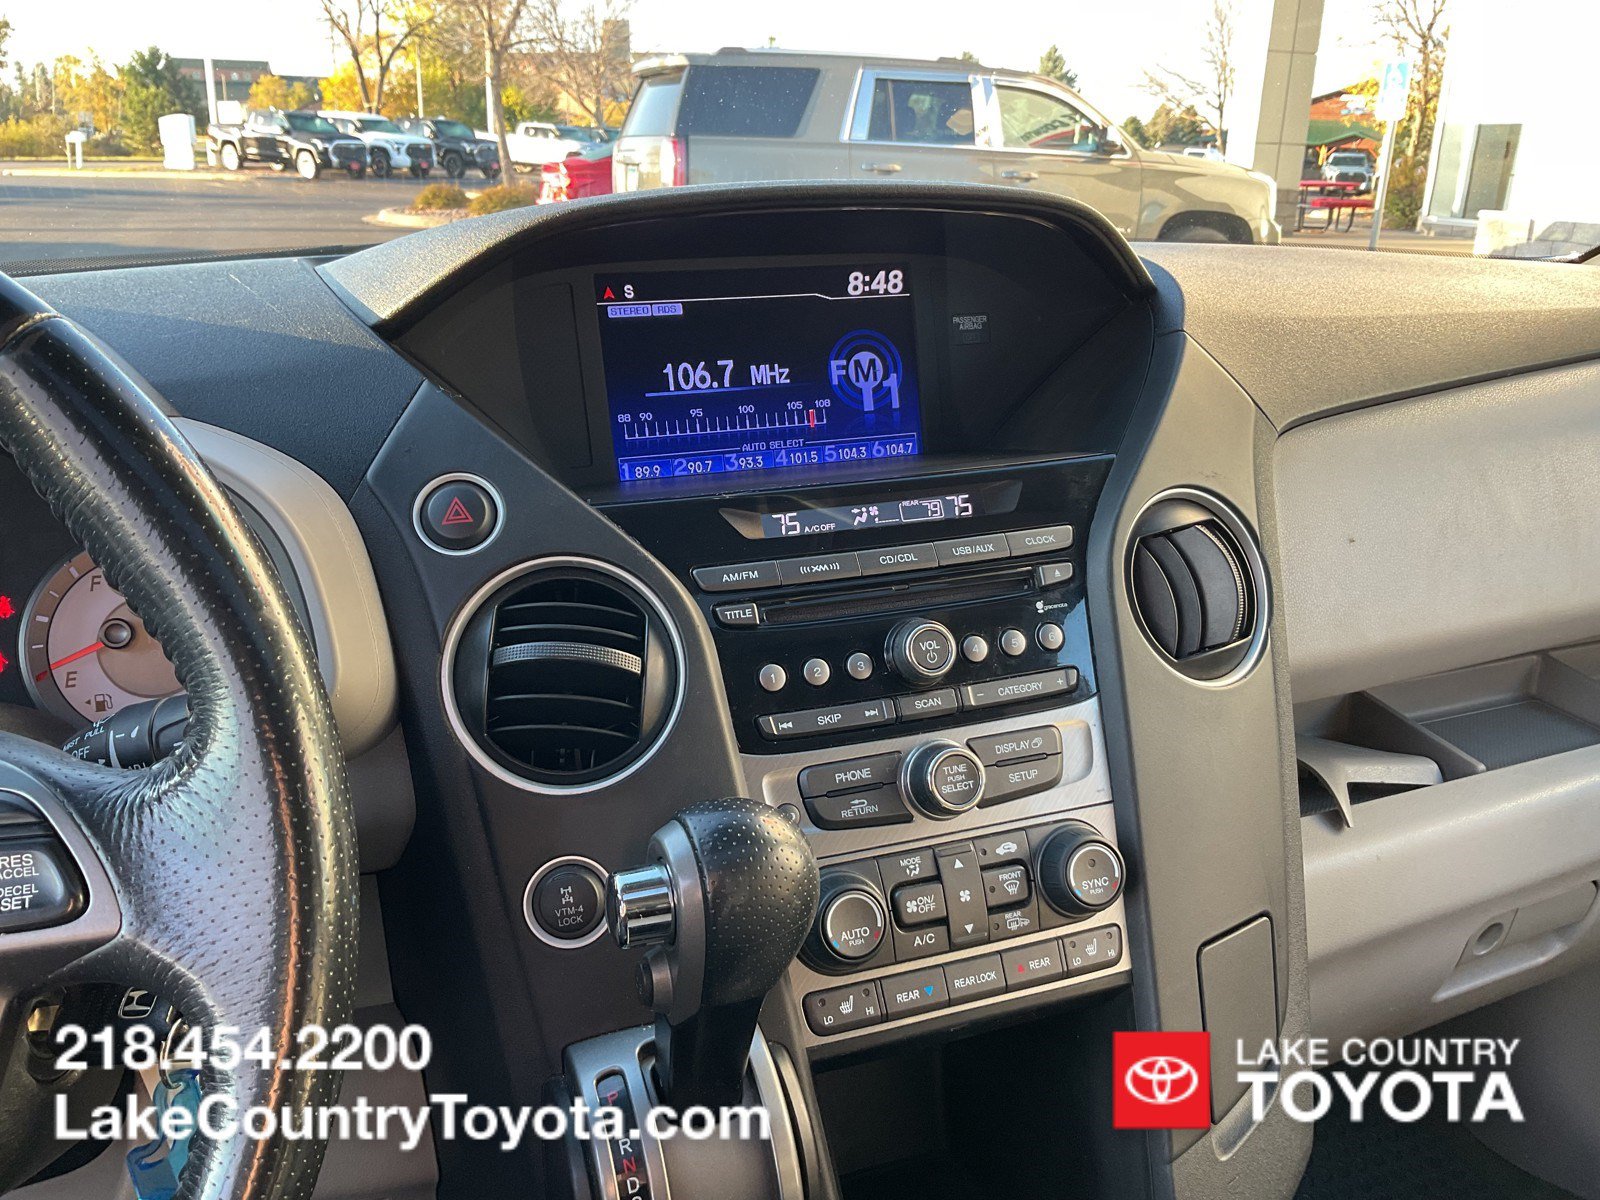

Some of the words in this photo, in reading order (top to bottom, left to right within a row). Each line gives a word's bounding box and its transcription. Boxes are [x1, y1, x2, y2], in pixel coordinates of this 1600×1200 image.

[847, 270, 904, 295] 8:48
[624, 284, 634, 299] S
[610, 306, 649, 316] STEREO
[657, 304, 677, 314] RDS
[952, 315, 988, 324] PASSENGER
[662, 359, 734, 391] 106.7
[750, 364, 790, 386] MHz
[618, 413, 631, 423] 88
[639, 412, 653, 422] 90
[690, 408, 703, 418] 95
[738, 404, 755, 414] 100
[786, 401, 803, 410] 105
[814, 399, 831, 408] 108
[742, 441, 766, 452] AUTO
[769, 438, 805, 449] SELECT
[634, 465, 661, 479] 89.9
[687, 460, 713, 474] 90.7
[738, 456, 764, 469] 93.3
[790, 451, 819, 464] 101.5
[838, 446, 867, 460] 104.3
[886, 442, 913, 456] 104.7
[945, 494, 973, 517] 75
[772, 512, 802, 536] 75
[1025, 534, 1056, 547] CLOCK
[952, 543, 995, 557] USB/AUX
[879, 552, 918, 565] CD/CDL
[722, 570, 759, 583] AM/FM
[90, 575, 102, 592] F
[724, 608, 753, 621] TITLE
[1011, 637, 1019, 649] 5
[1048, 632, 1056, 642] 6
[919, 640, 941, 651] VOL
[971, 643, 980, 654] 4
[813, 667, 822, 678] 2
[857, 661, 866, 671] 3
[64, 671, 78, 688] E
[770, 673, 776, 684] 1
[997, 681, 1043, 696] CATEGORY
[914, 696, 942, 709] SCAN
[817, 713, 842, 726] SKIP
[84, 726, 105, 740] PULL
[71, 745, 90, 759] OFF
[995, 739, 1030, 755] DISPLAY
[835, 767, 872, 783] PHONE
[942, 763, 968, 775] TUNE
[1008, 768, 1039, 783] SETUP
[947, 773, 966, 783] PUSH
[941, 779, 974, 794] SELECT
[841, 803, 879, 819] RETURN
[0, 853, 34, 869] RES
[900, 856, 922, 867] MODE
[998, 870, 1022, 881] FRONT
[1082, 876, 1109, 890] SYNC
[0, 894, 33, 911] SET
[917, 894, 935, 906] ON/
[554, 905, 584, 917] VTM-4
[918, 901, 937, 914] OFF
[558, 915, 584, 927] LOCK
[1004, 911, 1022, 920] REAR
[841, 926, 870, 941] AUTO
[913, 932, 936, 947] A/C
[848, 939, 865, 947] PUSH
[1107, 949, 1116, 958] HI
[1028, 957, 1051, 970] REAR
[1072, 957, 1082, 966] LO
[954, 976, 975, 988] REAR
[974, 971, 998, 984] LOCK
[896, 989, 920, 1004] REAR
[865, 1006, 875, 1016] HI
[823, 1015, 834, 1026] LO
[618, 1138, 633, 1155] R
[622, 1155, 637, 1175] N
[626, 1176, 640, 1194] D
